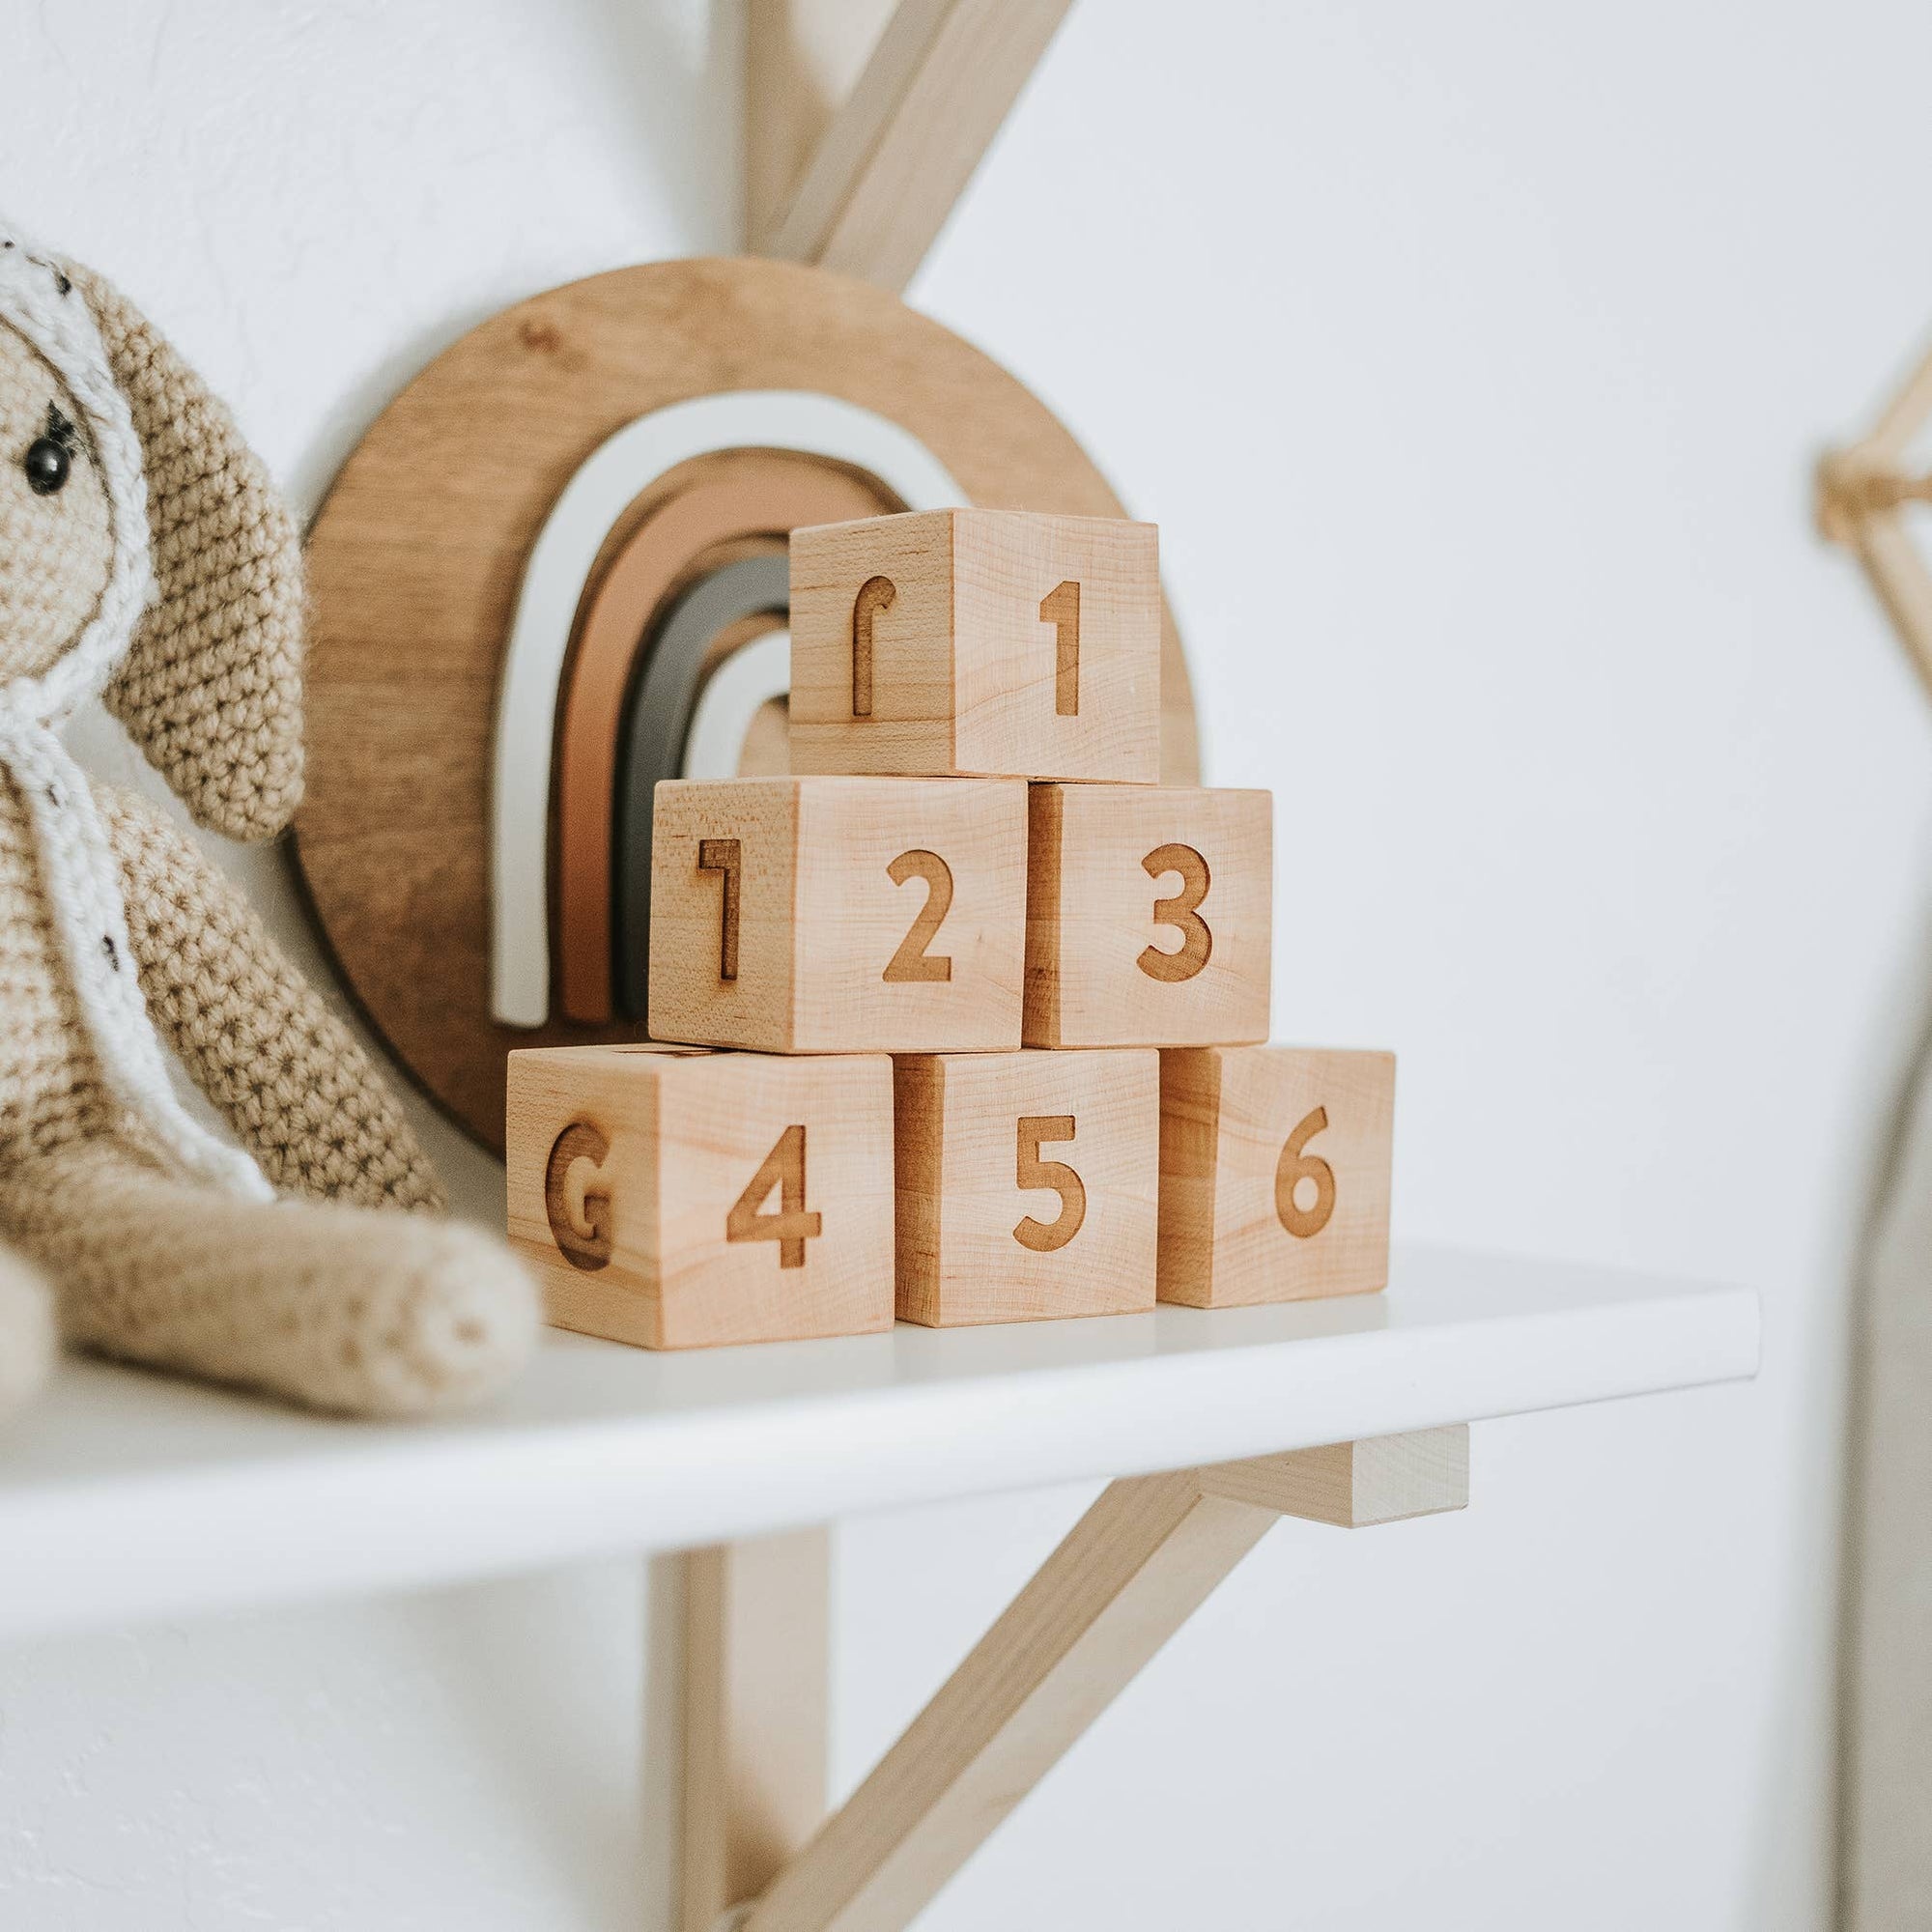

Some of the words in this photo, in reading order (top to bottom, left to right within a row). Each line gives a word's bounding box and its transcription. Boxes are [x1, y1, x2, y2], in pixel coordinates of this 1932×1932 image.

[1039, 581, 1080, 717] 1
[883, 849, 954, 982] 2
[1136, 842, 1213, 982] 3
[545, 1121, 611, 1272] G
[725, 1124, 822, 1269] 4
[1012, 1115, 1087, 1252] 5
[1274, 1105, 1337, 1239] 6
